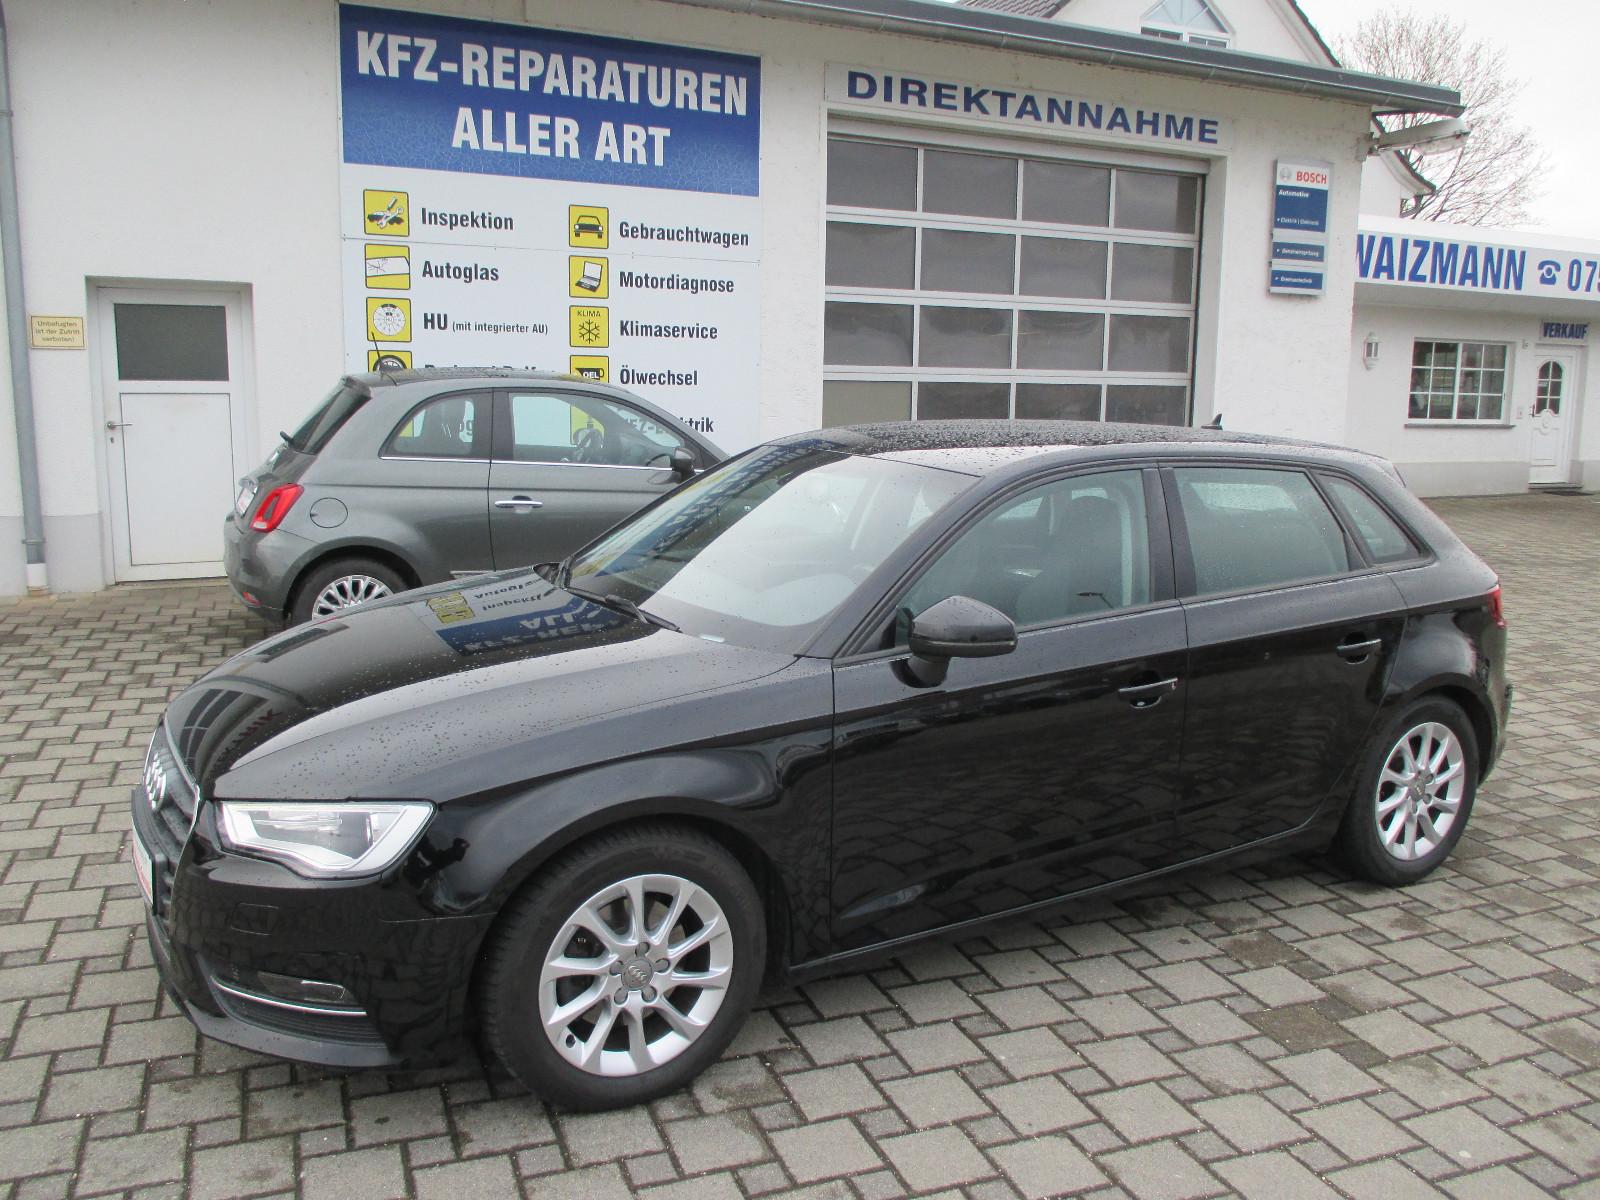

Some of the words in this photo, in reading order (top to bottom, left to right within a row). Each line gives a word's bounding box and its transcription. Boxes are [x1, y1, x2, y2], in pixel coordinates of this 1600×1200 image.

[356, 30, 748, 116] KFZ-REPARATUREN
[847, 71, 1219, 145] DIREKTANNAHME
[451, 106, 581, 160] ALLER
[594, 121, 671, 167] ART
[1296, 171, 1327, 184] BOSCH
[421, 207, 514, 231] Inspektion
[619, 221, 749, 249] Gebrauchtwagen
[422, 260, 499, 284] Autoglas
[619, 271, 735, 295] Motordiagnose
[423, 312, 448, 331] HU
[452, 321, 472, 332] (mit
[474, 322, 528, 335] integrierter
[532, 322, 548, 335] AU)
[619, 319, 718, 340] Klimaservice
[1542, 322, 1589, 339] VERKAUF
[582, 371, 600, 379] OEL
[619, 365, 698, 386] Ölwechsel
